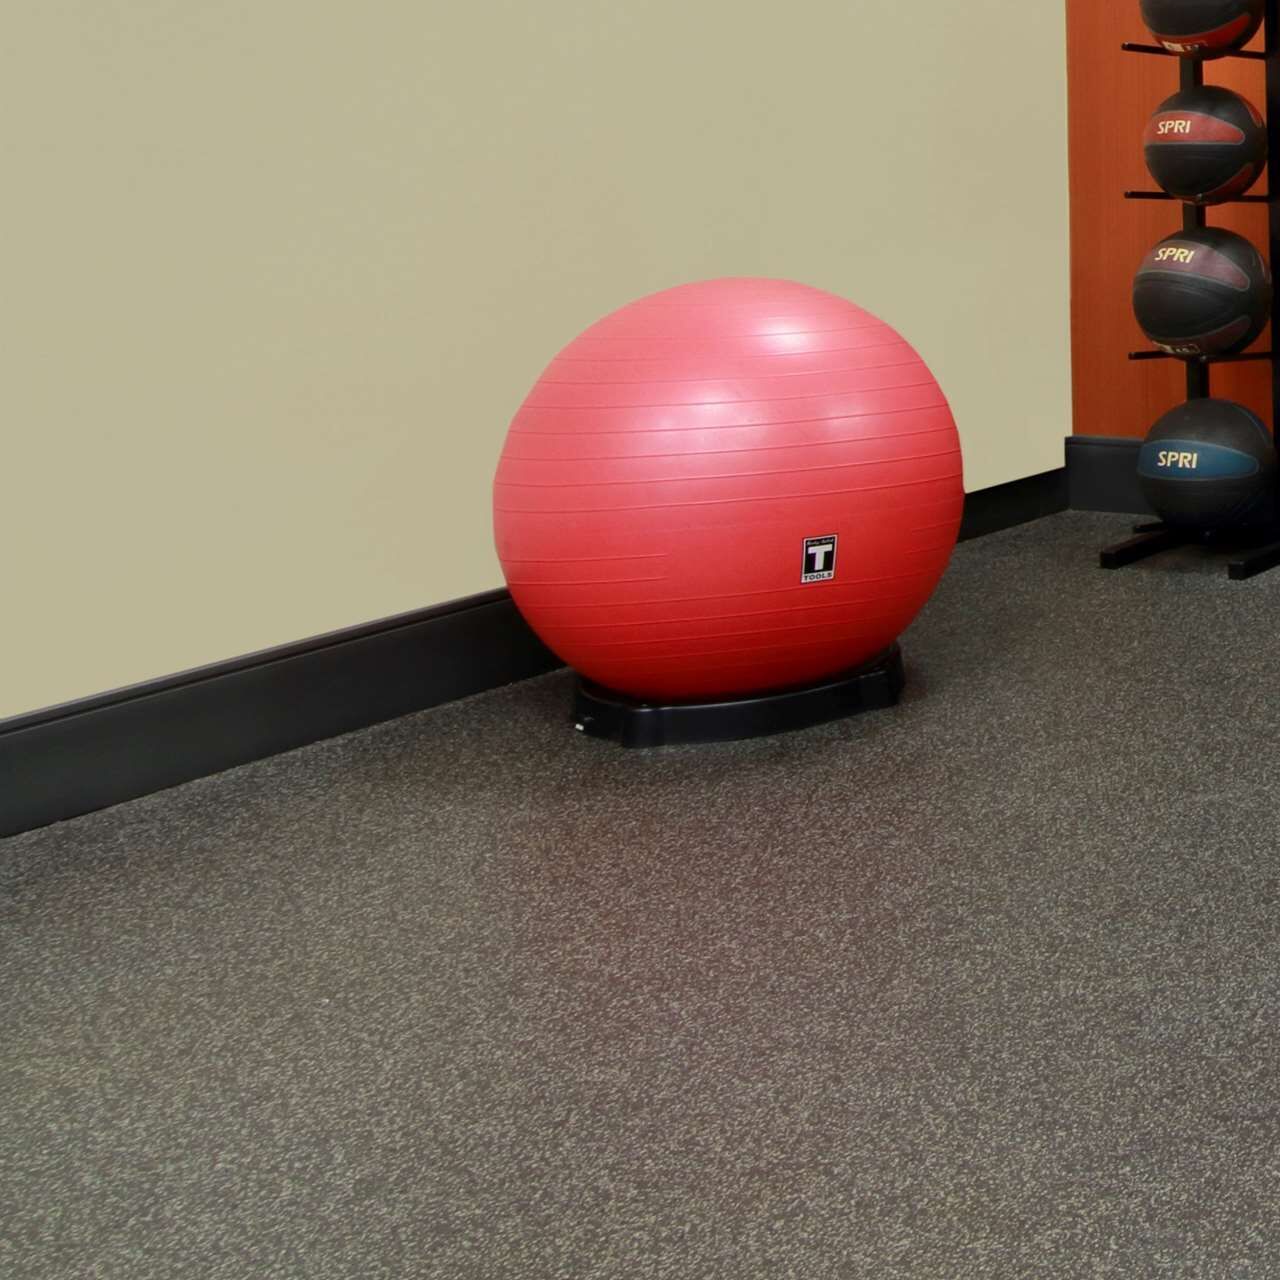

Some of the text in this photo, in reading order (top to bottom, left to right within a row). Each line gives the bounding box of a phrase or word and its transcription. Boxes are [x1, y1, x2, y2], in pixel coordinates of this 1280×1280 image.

[1156, 120, 1191, 135] SPRI
[1155, 248, 1195, 264] SPRI
[1157, 451, 1198, 469] SPRI
[807, 543, 833, 571] T
[804, 572, 833, 581] TOOLS
